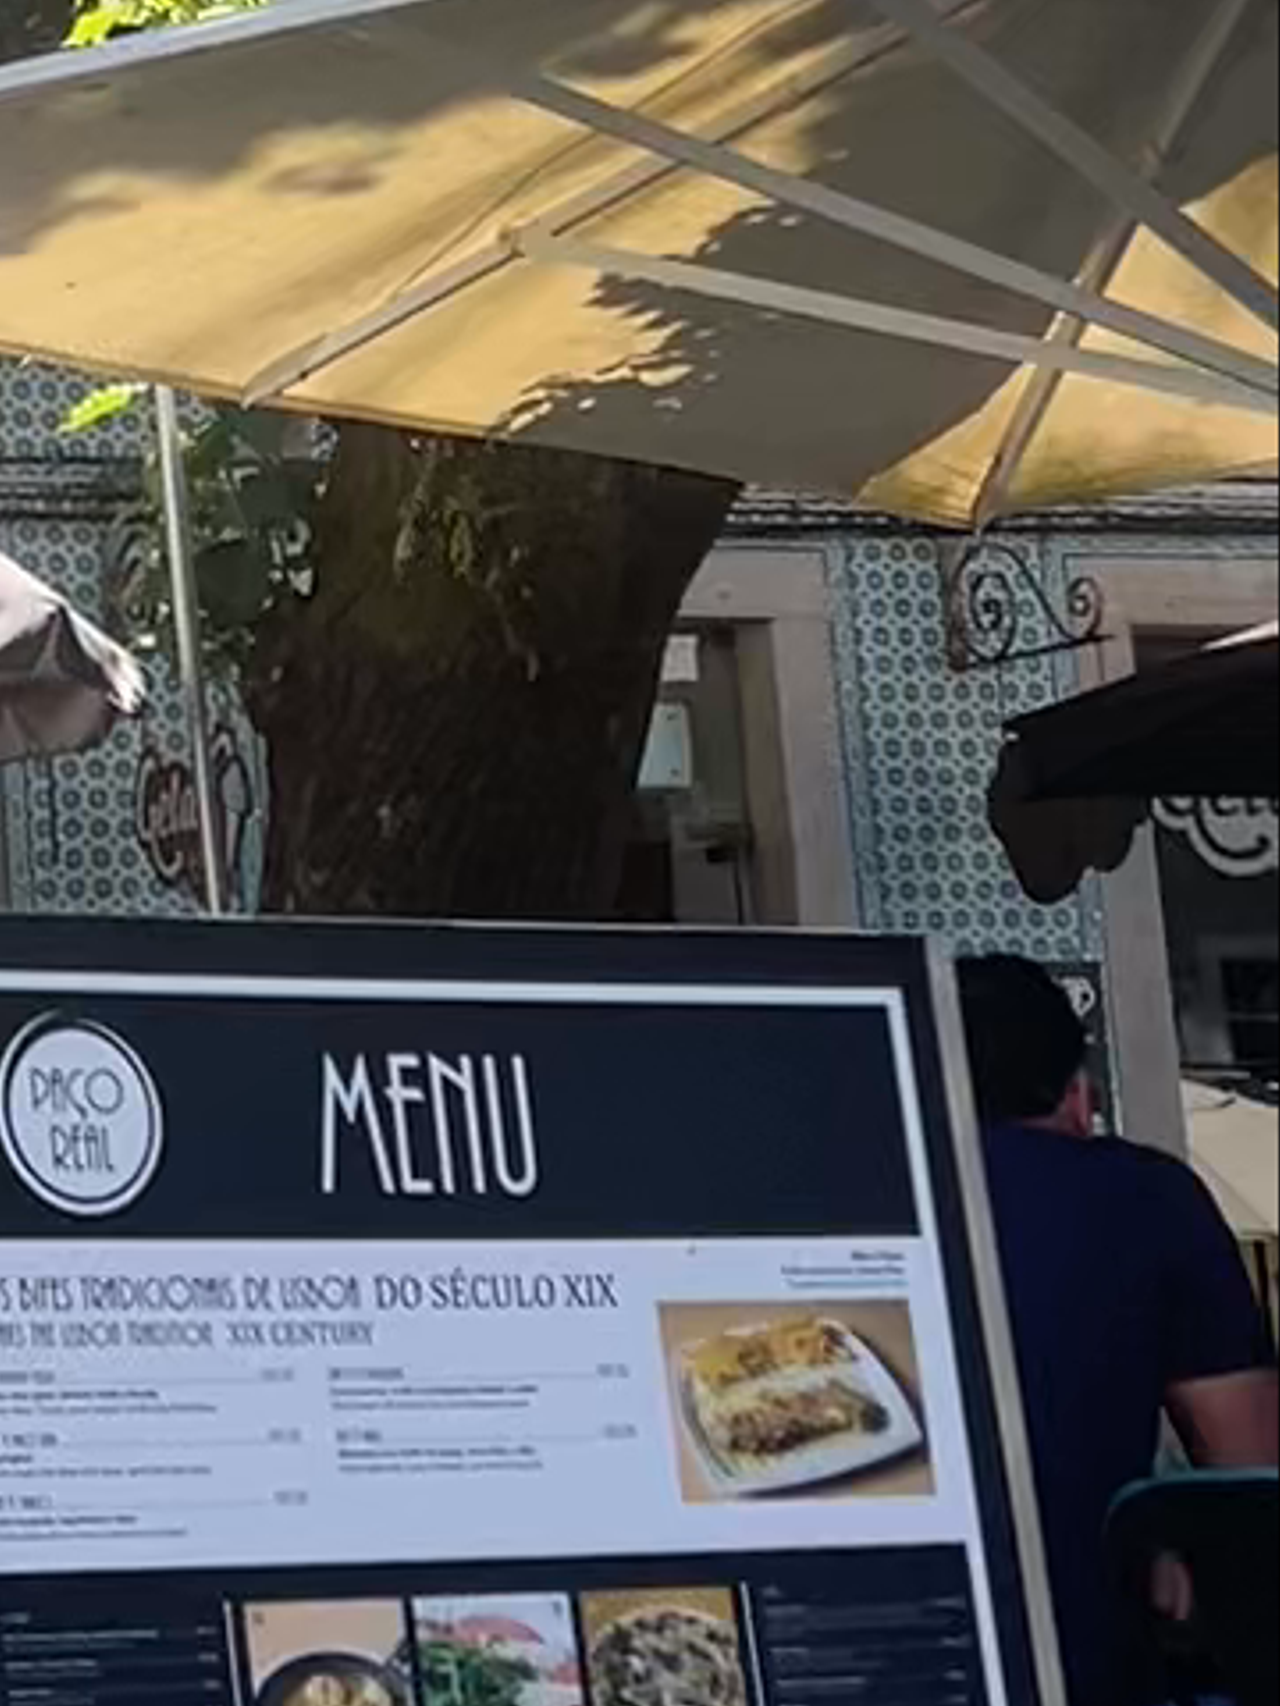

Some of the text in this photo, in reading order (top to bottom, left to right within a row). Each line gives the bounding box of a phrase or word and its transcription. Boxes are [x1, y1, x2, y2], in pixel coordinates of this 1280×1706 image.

[29, 1067, 124, 1120] PAÇO
[322, 1051, 537, 1195] MENU
[50, 1124, 114, 1173] REAL
[243, 1276, 272, 1310] DE
[374, 1274, 423, 1310] DO
[431, 1266, 555, 1309] SÉCULO
[562, 1273, 619, 1308] XIX
[226, 1322, 266, 1346] XIX
[270, 1321, 374, 1347] CENTURY
